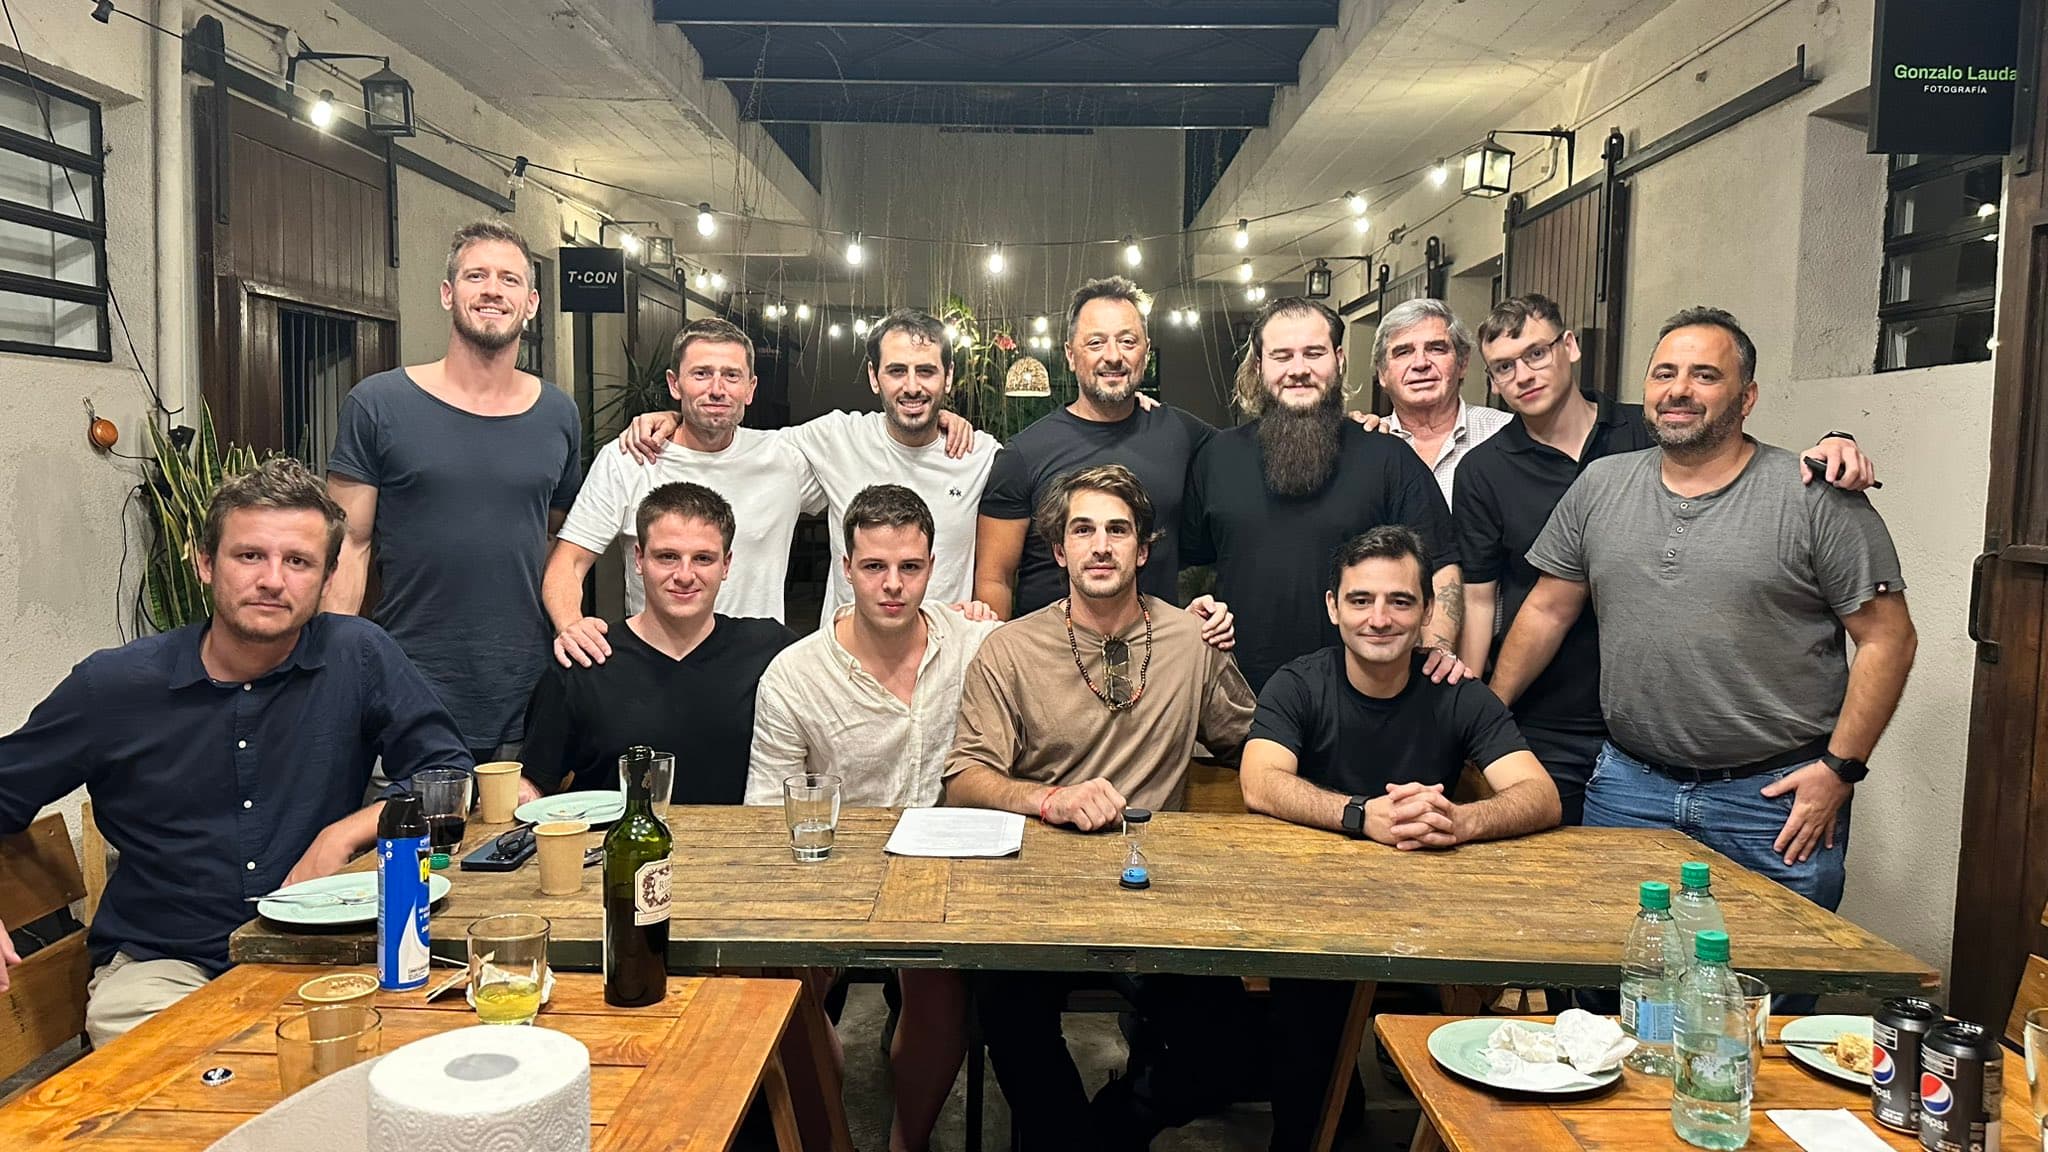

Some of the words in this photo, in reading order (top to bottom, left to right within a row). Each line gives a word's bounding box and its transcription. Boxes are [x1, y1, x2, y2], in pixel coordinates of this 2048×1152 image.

[1894, 64, 1963, 80] Gonzalo
[1967, 66, 2017, 81] Lauda
[1923, 84, 1988, 94] FOTOGRAFÍA
